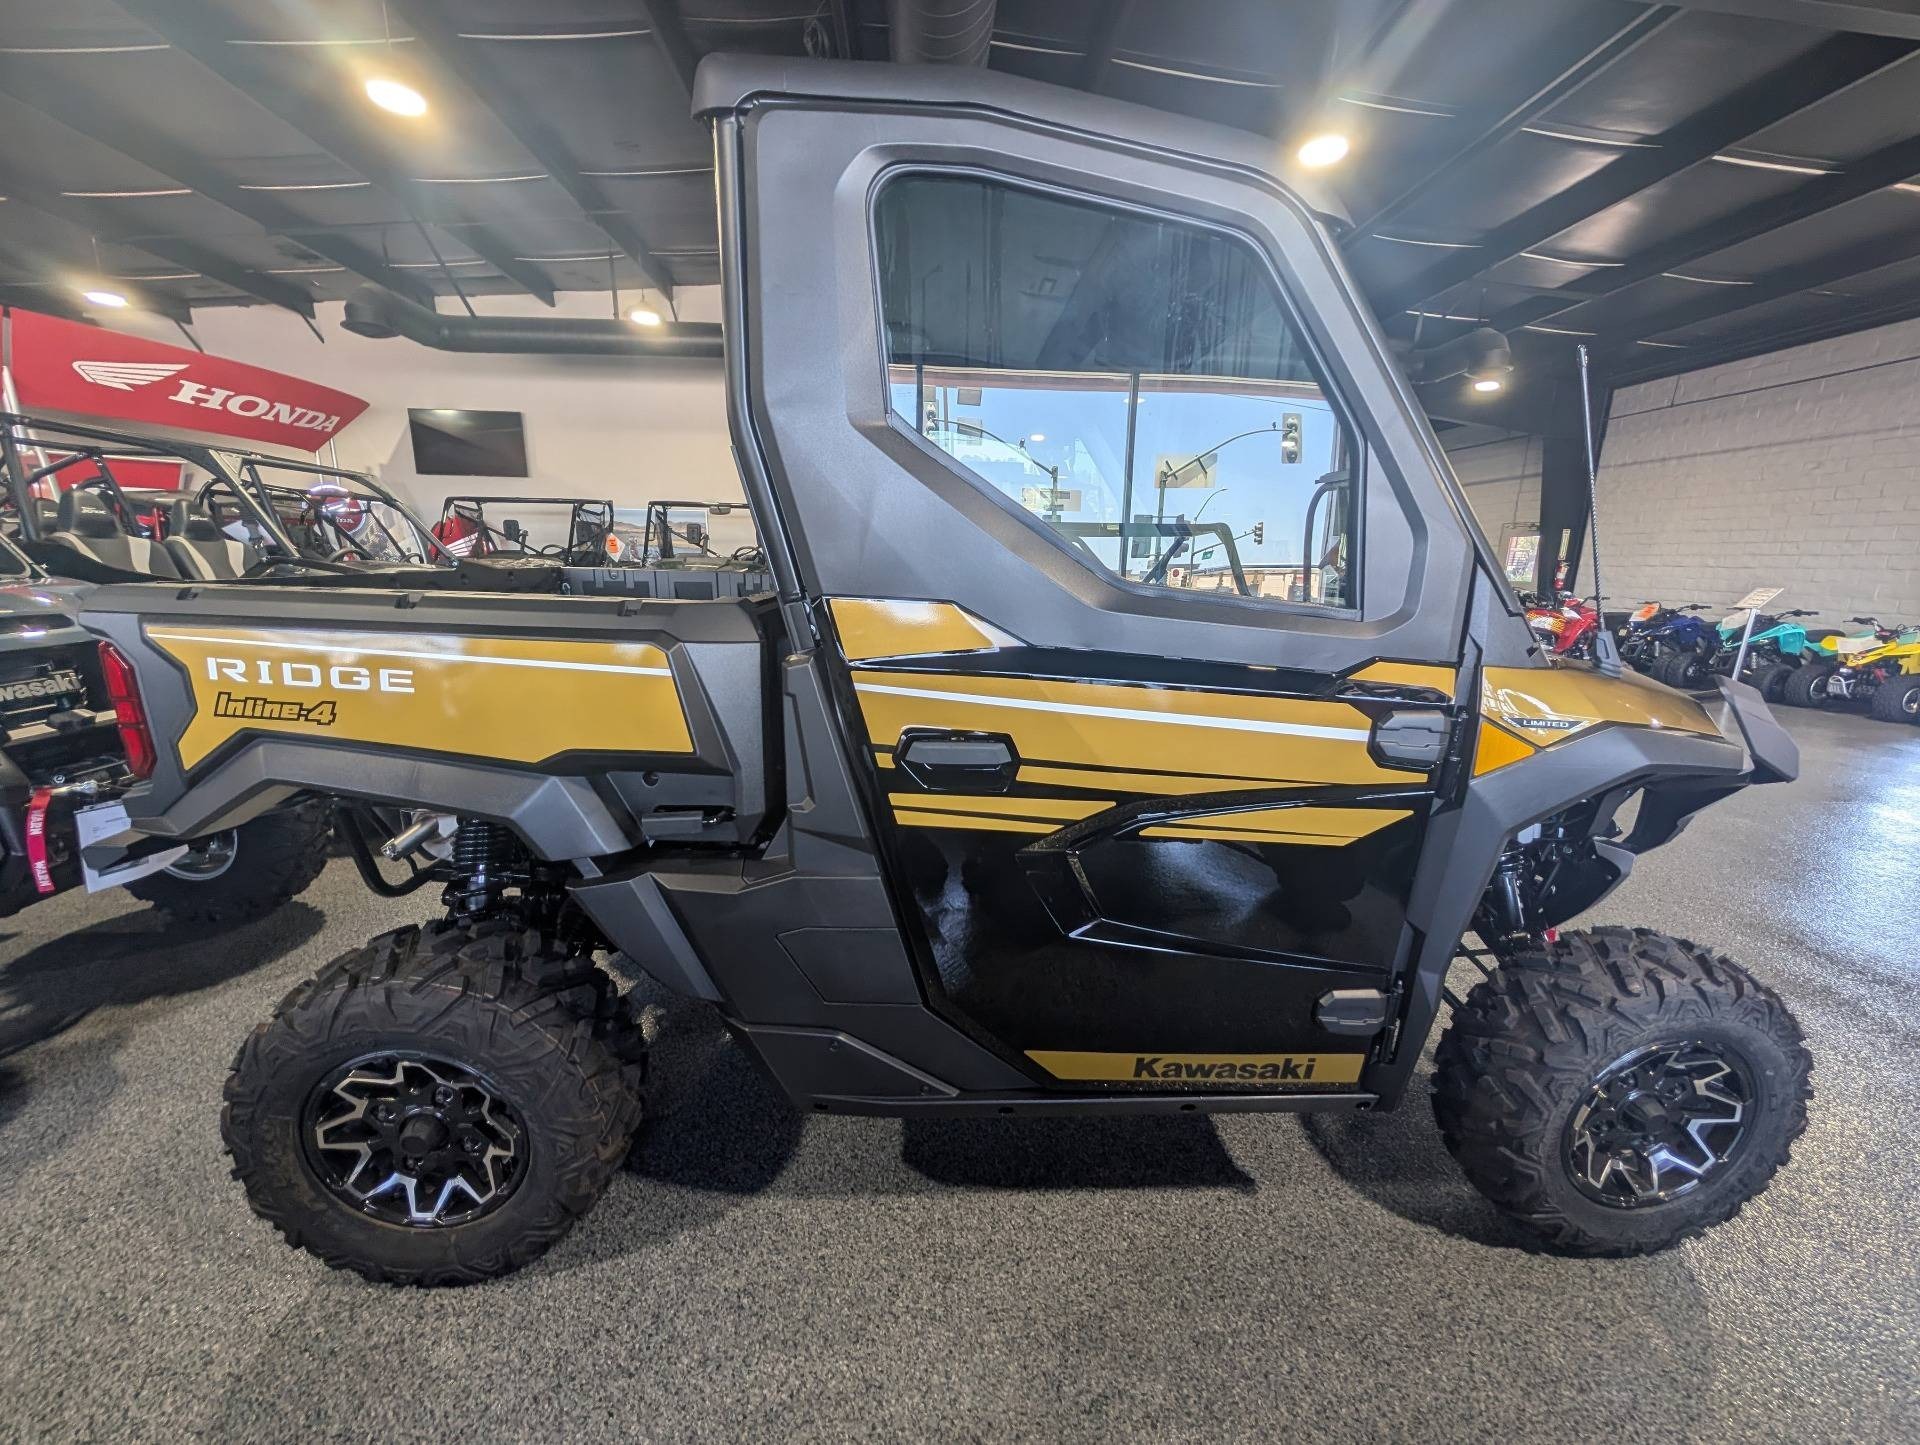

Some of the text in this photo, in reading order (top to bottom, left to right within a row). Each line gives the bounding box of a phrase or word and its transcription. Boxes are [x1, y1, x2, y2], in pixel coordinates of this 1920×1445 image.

[168, 379, 341, 432] HONDA
[206, 657, 415, 693] RIDGE
[214, 691, 337, 726] Inline-4
[1522, 719, 1569, 728] LIMITED
[29, 809, 46, 836] WARN
[33, 860, 53, 888] WARN
[1132, 1057, 1317, 1080] Kawasaki
